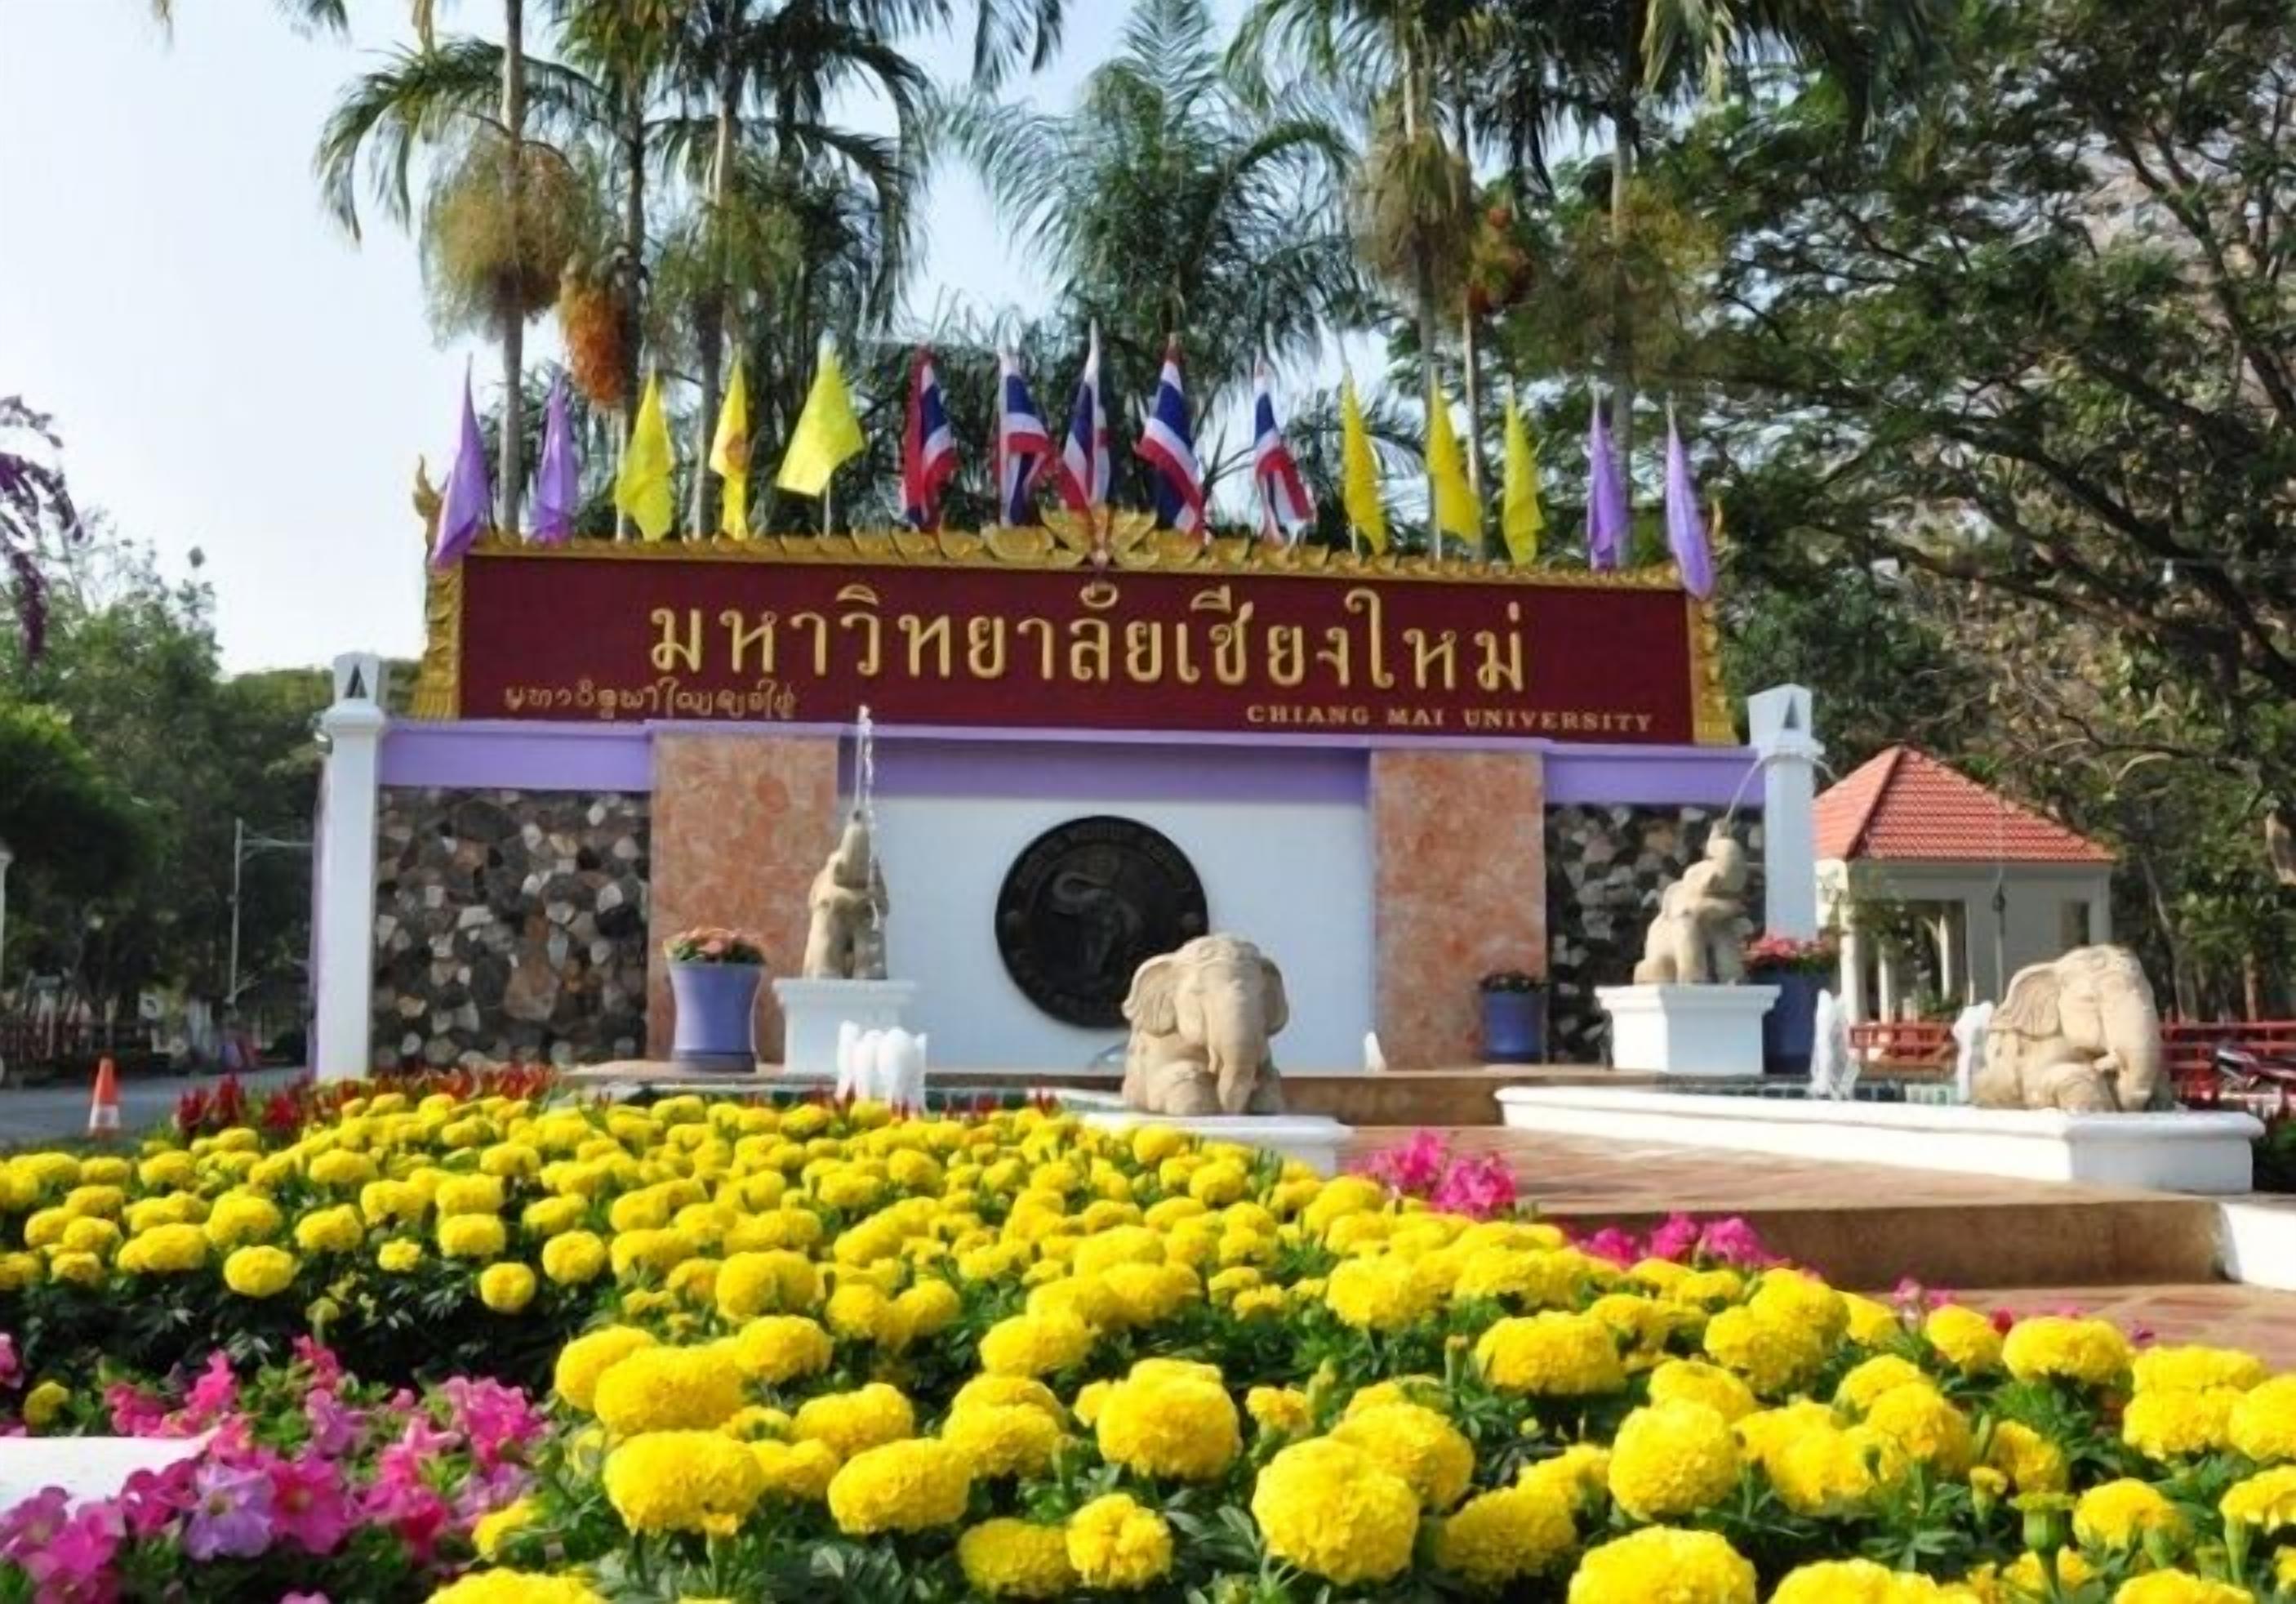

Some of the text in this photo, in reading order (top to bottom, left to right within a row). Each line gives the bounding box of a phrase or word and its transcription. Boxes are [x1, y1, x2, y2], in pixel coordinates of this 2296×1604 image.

[651, 582, 1525, 693] มหาวิทยาลัยเชียงใหม่
[1246, 705, 1653, 733] CHIANG MAI UNIVERSITY
